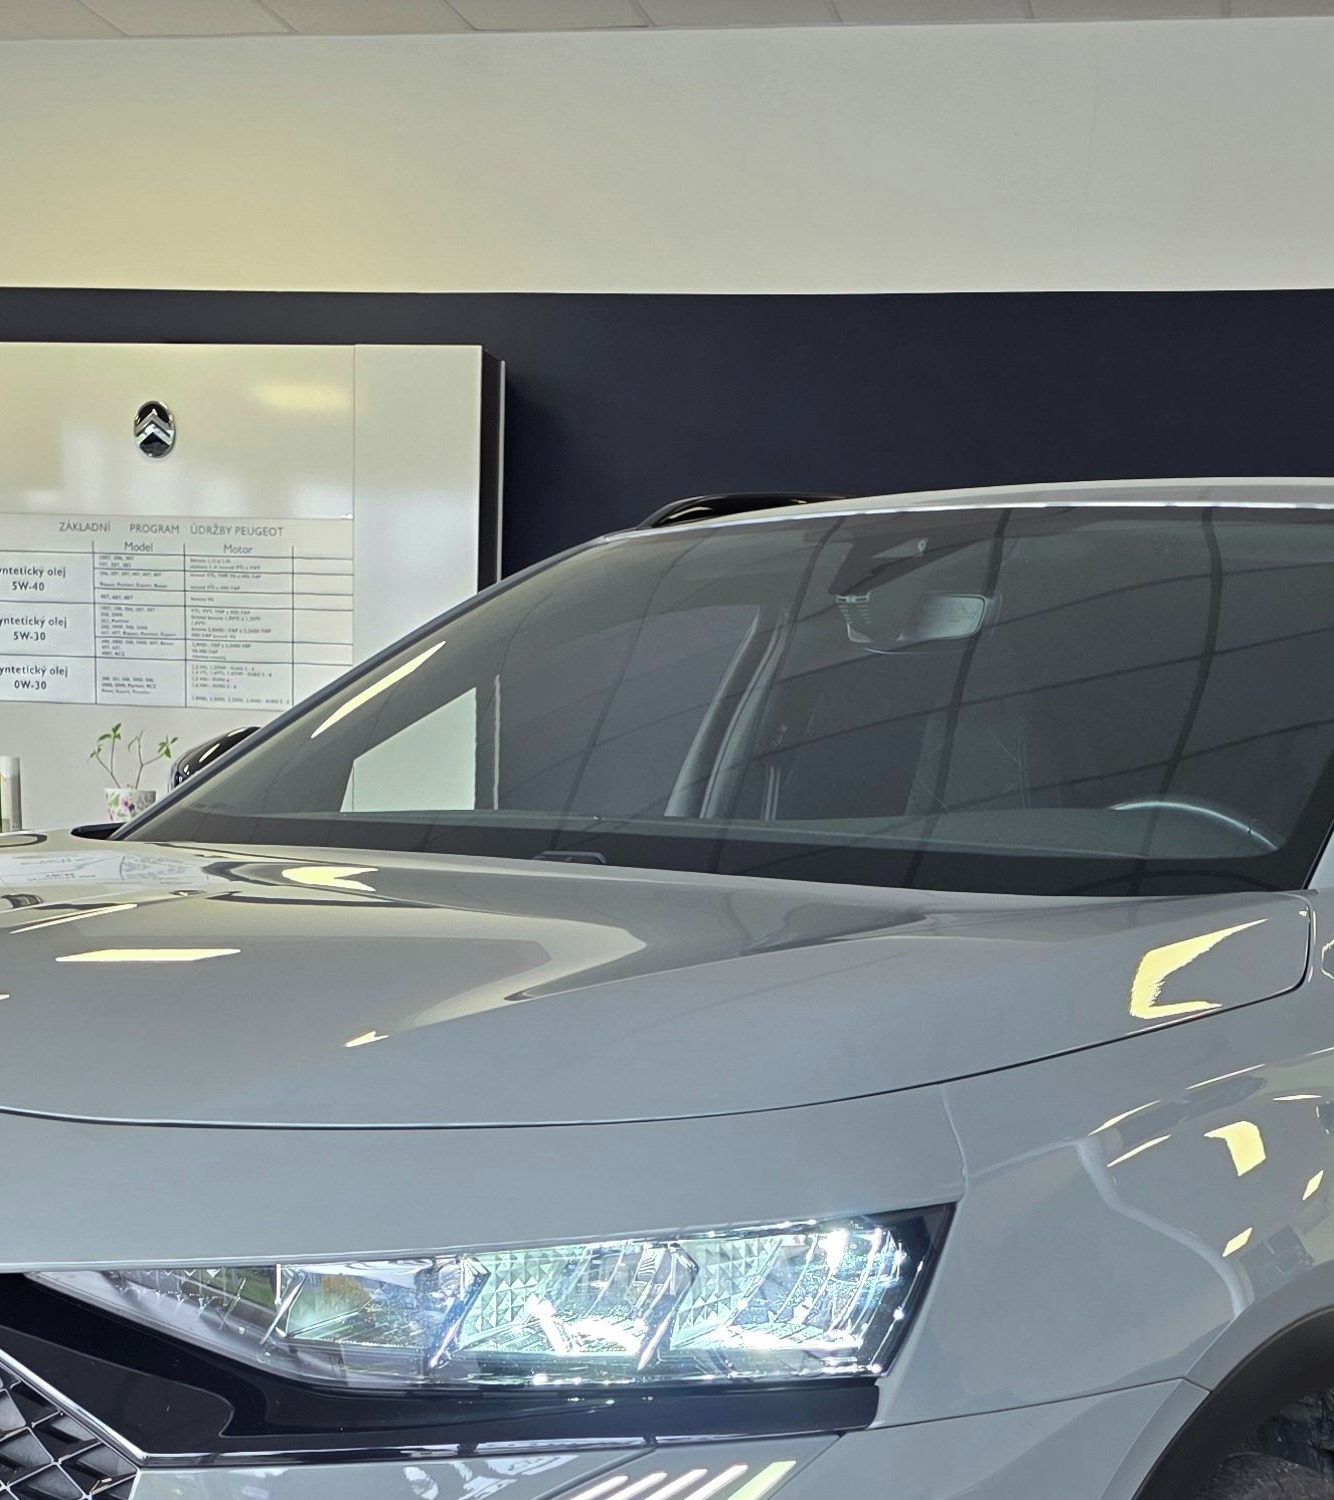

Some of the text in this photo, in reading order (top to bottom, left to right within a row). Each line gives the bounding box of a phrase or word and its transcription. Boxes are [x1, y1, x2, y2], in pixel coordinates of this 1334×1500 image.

[59, 520, 284, 537] ZÁKLADNÍ PROGRAM ÚDRŽBY PEUGEOT
[124, 541, 154, 552] Model
[223, 543, 254, 554] Motor
[47, 566, 66, 578] olej
[12, 581, 45, 592] 5W-40
[48, 616, 67, 629] olej
[13, 631, 46, 641] 5W-30
[49, 665, 69, 678] olej
[14, 680, 47, 690] 0W-30
